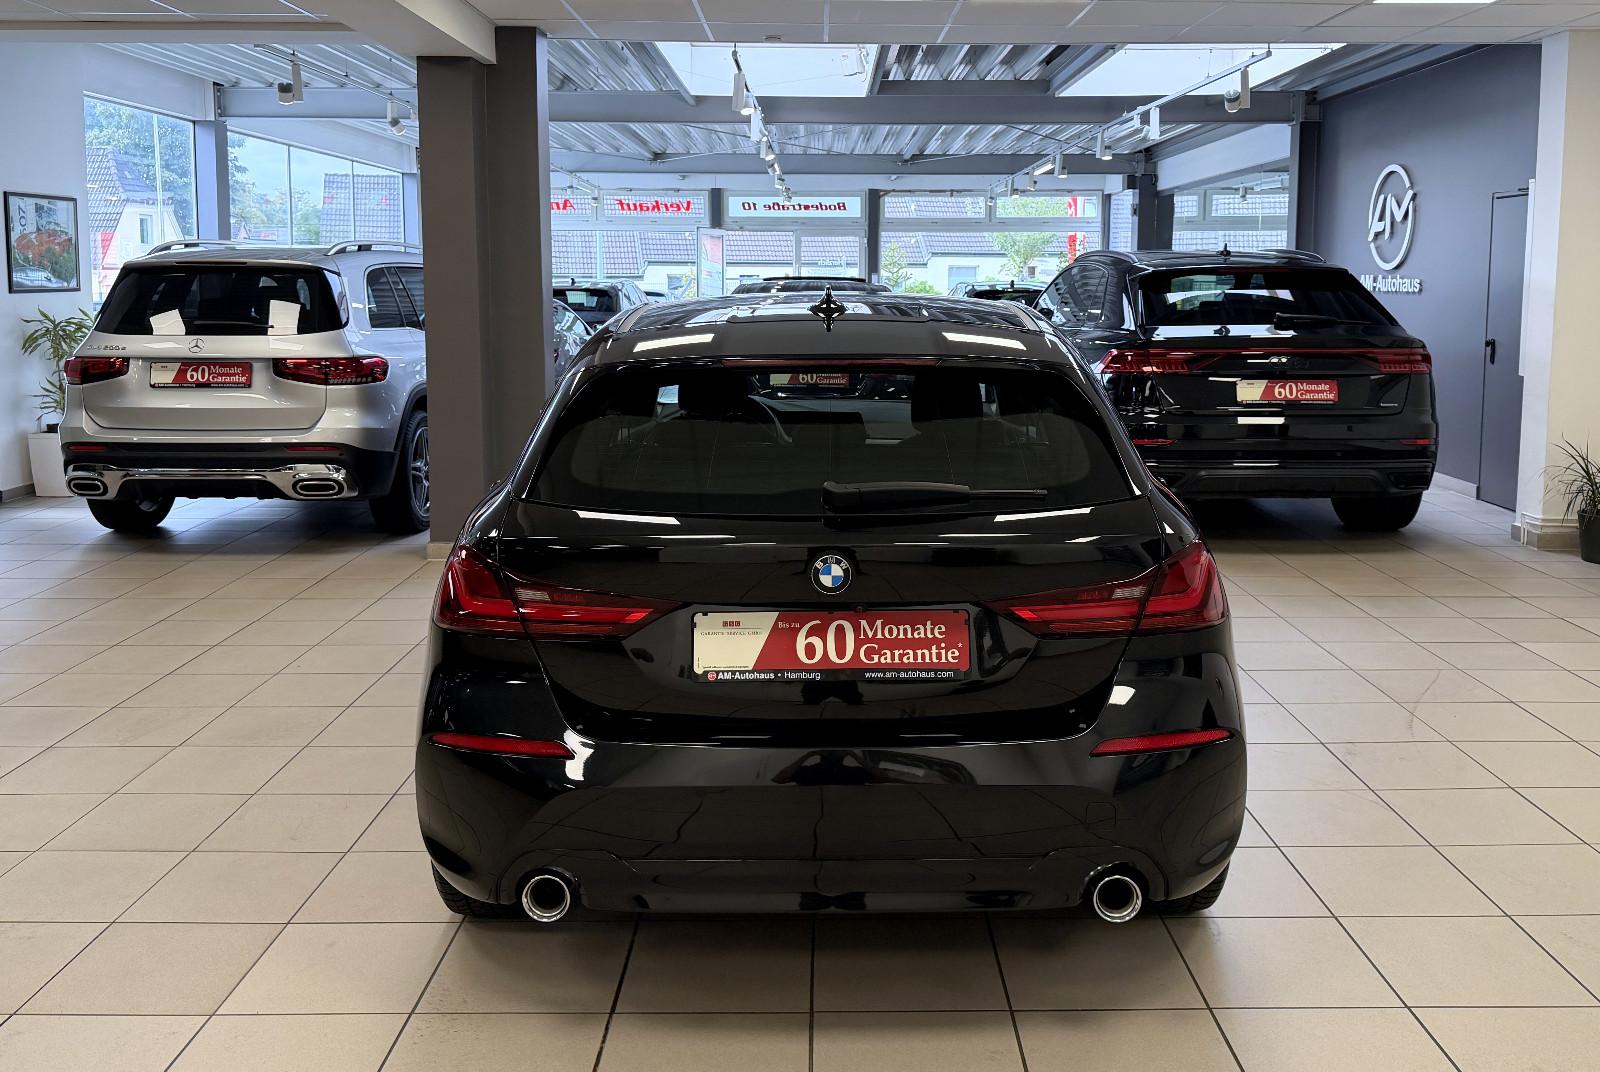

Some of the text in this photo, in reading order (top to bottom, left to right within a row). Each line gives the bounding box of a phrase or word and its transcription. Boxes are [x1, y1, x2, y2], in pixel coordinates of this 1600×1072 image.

[186, 365, 209, 382] 60
[210, 366, 242, 374] Monate
[1274, 382, 1297, 399] 60
[1298, 383, 1330, 391] Monate
[815, 556, 848, 570] BMW
[778, 621, 790, 629] Bis
[858, 619, 946, 639] Monate
[796, 619, 855, 664] 60
[717, 671, 775, 680] AM-Autohaus
[784, 671, 821, 681] Hamburg
[864, 670, 954, 678] www.am-autohaus.com
